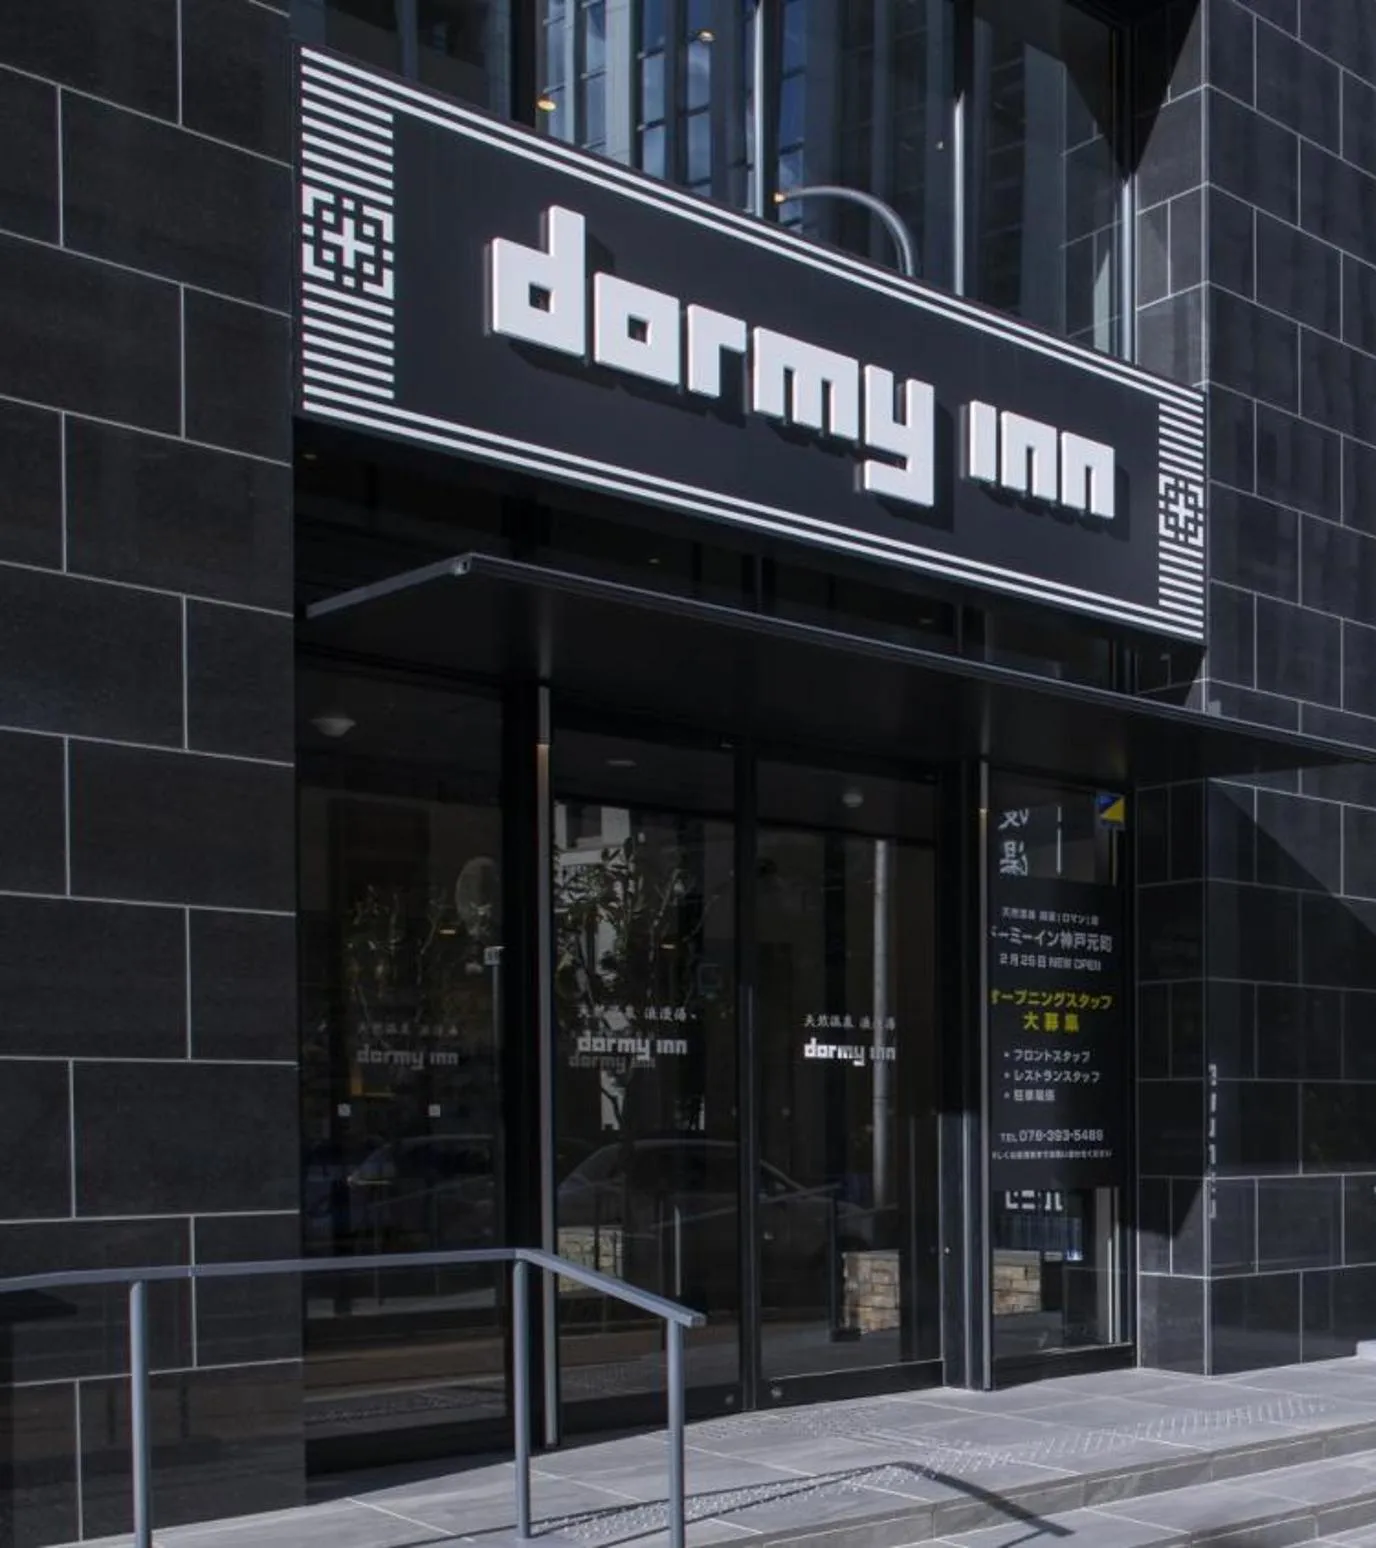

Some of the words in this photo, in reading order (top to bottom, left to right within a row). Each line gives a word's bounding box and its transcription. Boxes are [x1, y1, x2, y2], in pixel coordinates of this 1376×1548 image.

[490, 204, 935, 508] dormy
[966, 399, 1115, 520] inn
[577, 1029, 651, 1061] dormy
[804, 1036, 866, 1067] dormy
